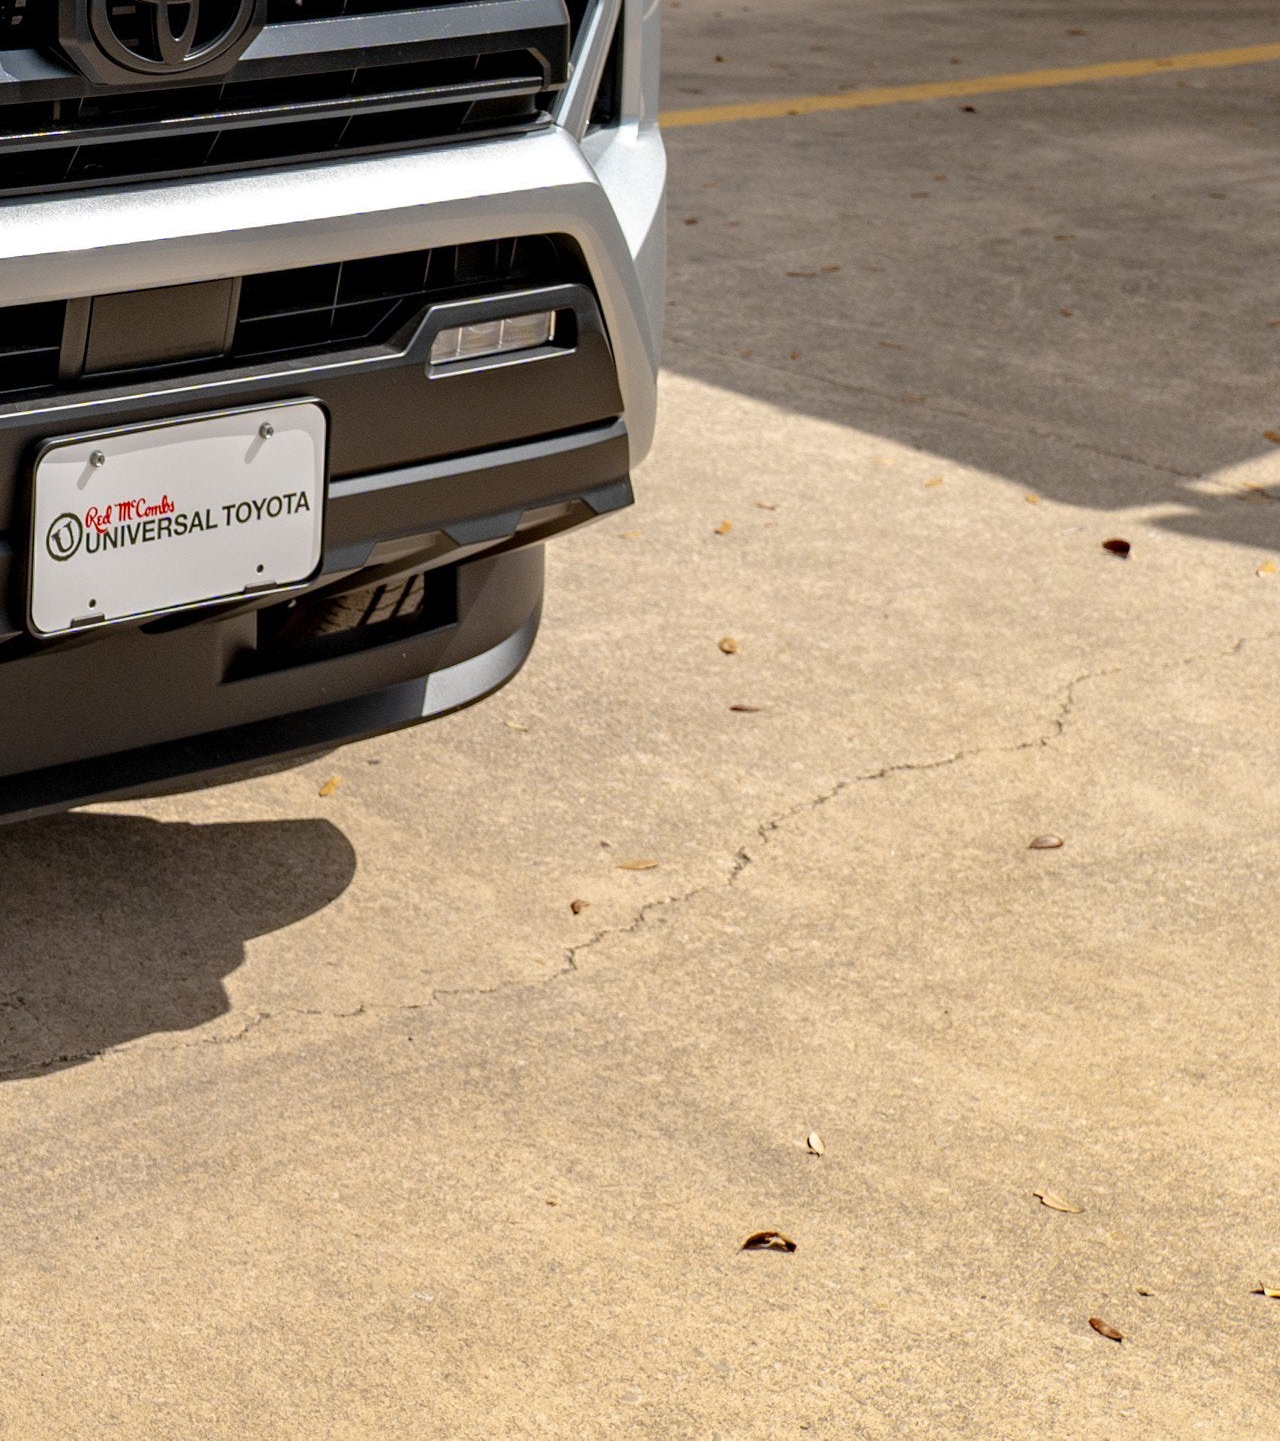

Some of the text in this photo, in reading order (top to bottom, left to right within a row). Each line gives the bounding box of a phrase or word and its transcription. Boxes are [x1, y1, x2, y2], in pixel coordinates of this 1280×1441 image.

[85, 494, 175, 535] Red McCombs
[85, 490, 311, 554] UNIVERSAL TOYOTA
